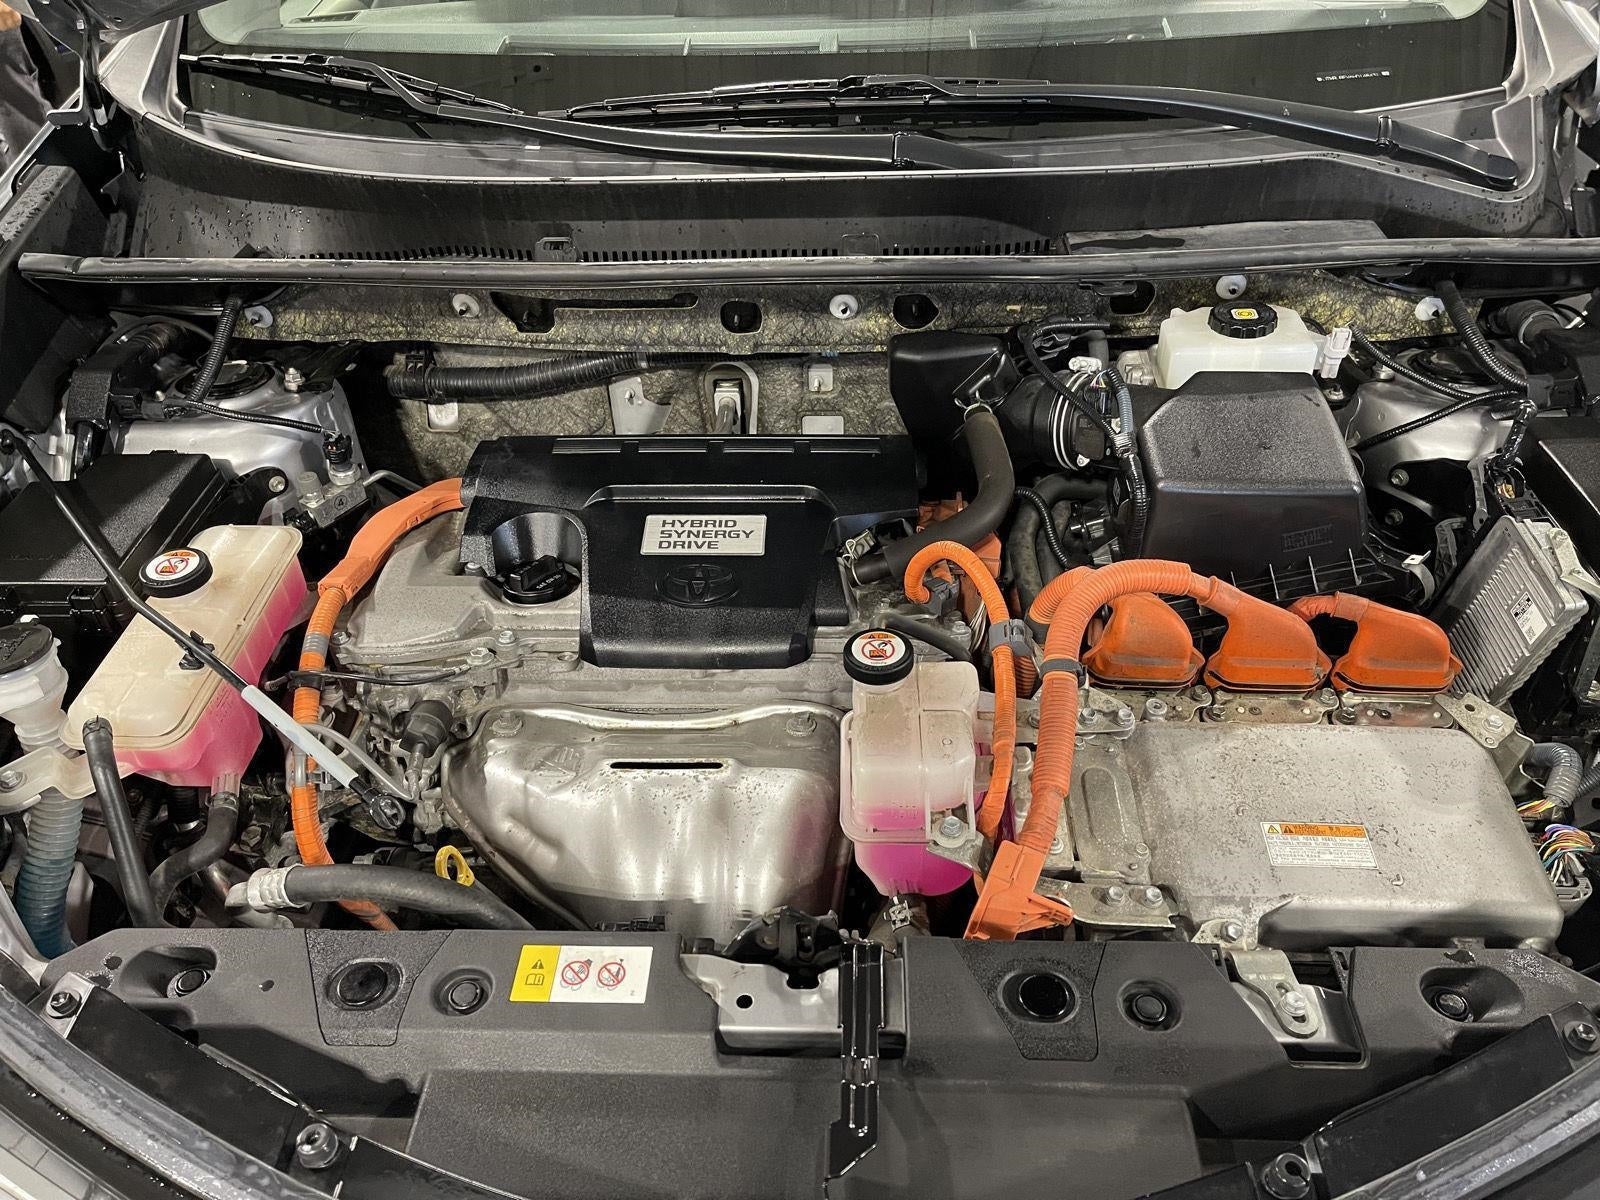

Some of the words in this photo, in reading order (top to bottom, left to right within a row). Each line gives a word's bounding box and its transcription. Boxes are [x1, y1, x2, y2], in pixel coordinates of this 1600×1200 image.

[661, 519, 738, 528] HYBRID
[659, 529, 755, 539] SYNERGY
[658, 540, 720, 550] DRIVE
